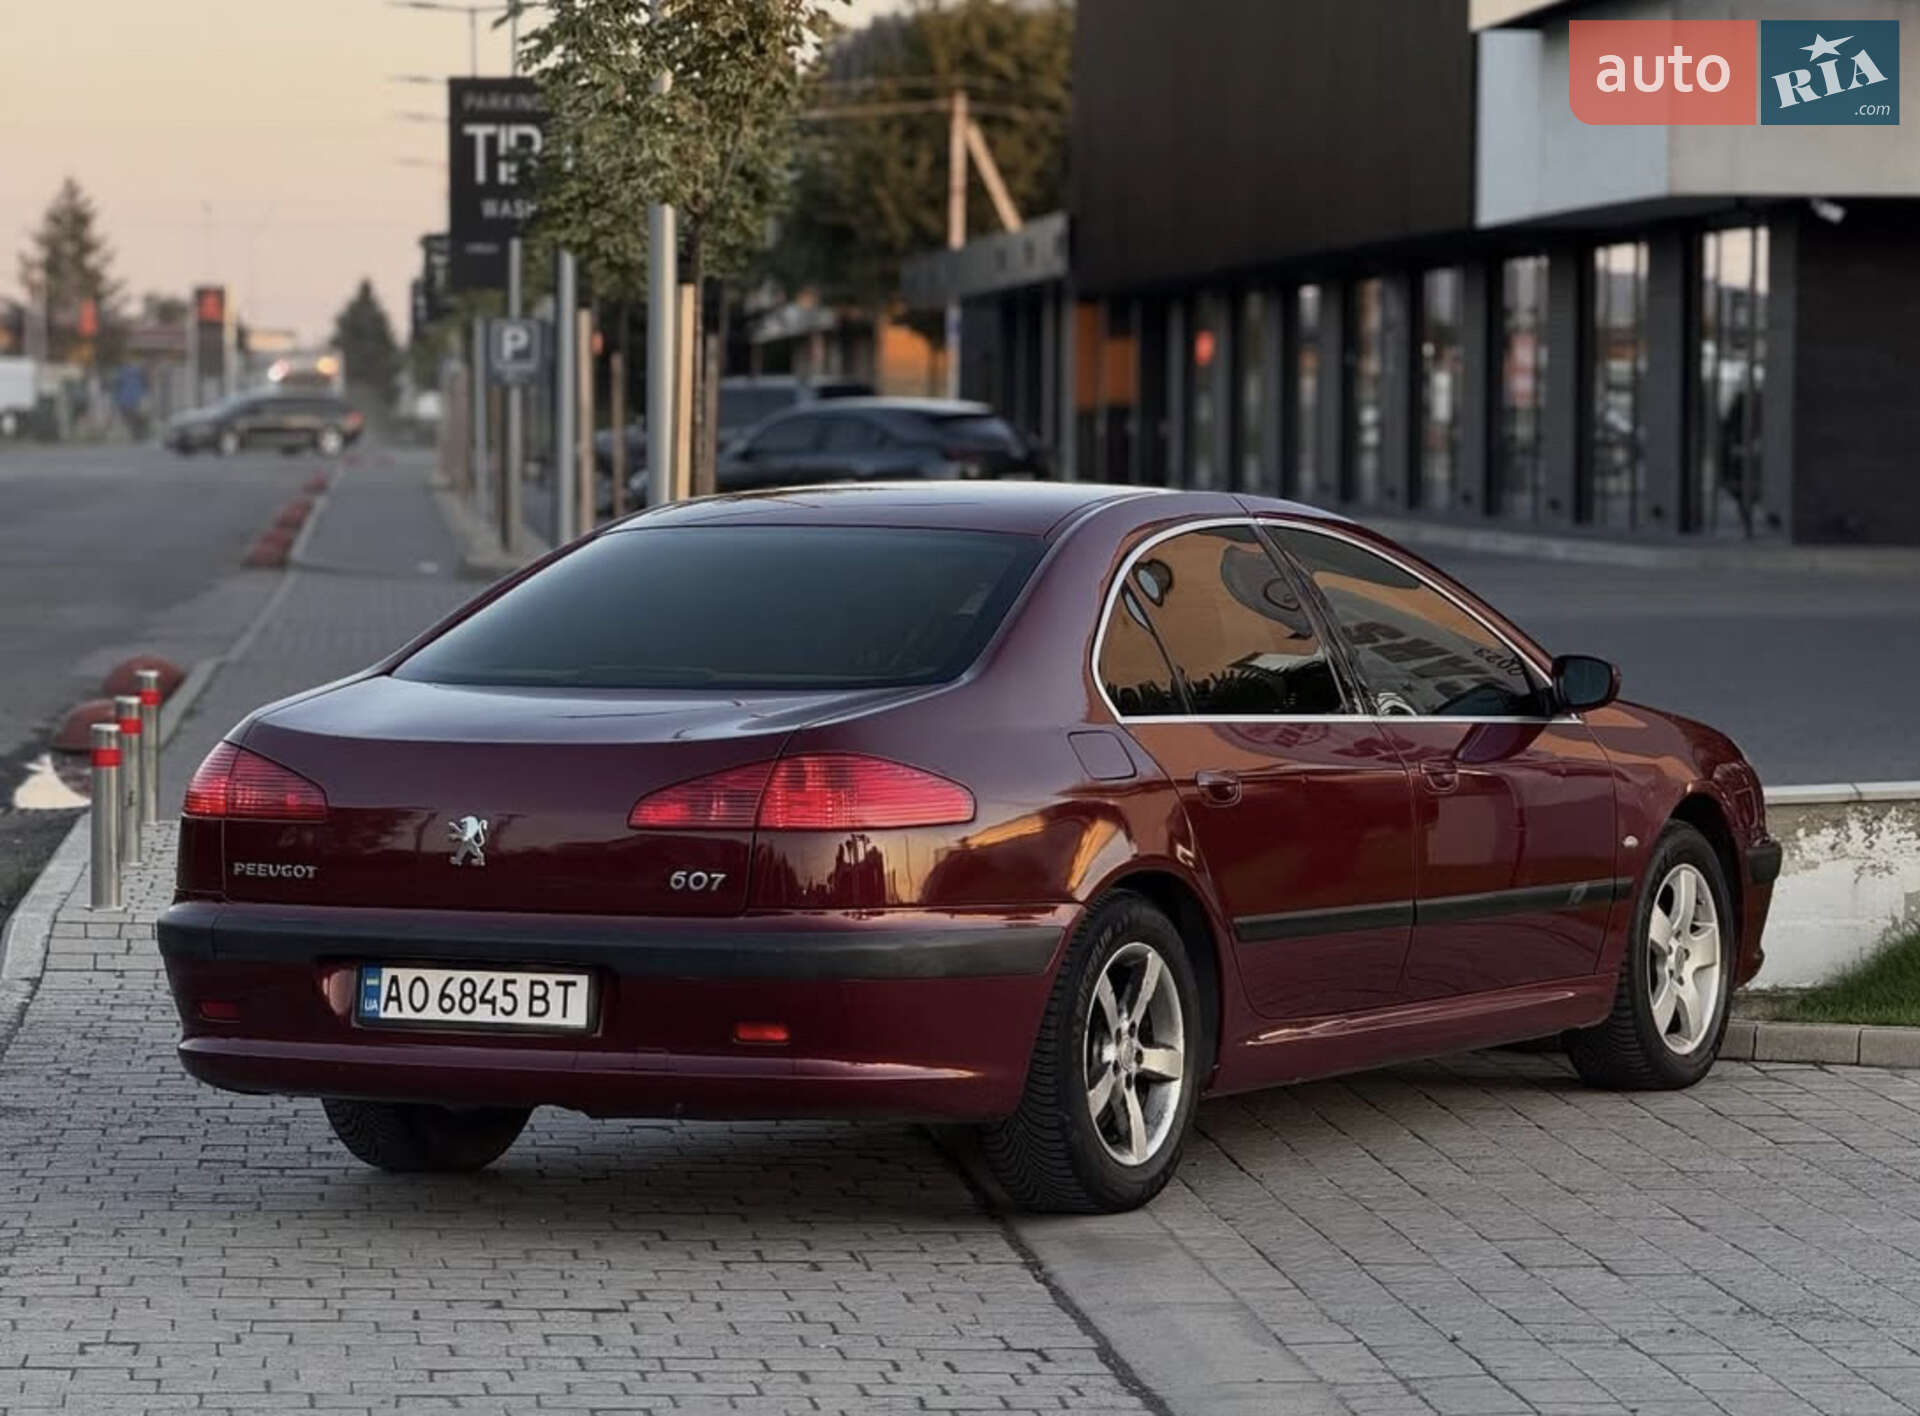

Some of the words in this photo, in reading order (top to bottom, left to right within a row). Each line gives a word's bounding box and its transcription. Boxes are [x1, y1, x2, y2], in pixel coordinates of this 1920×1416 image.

[502, 327, 528, 362] P
[669, 870, 727, 891] 607
[364, 998, 379, 1012] UA
[382, 975, 430, 1014] AO
[438, 977, 518, 1017] 6845
[528, 980, 577, 1018] BT
